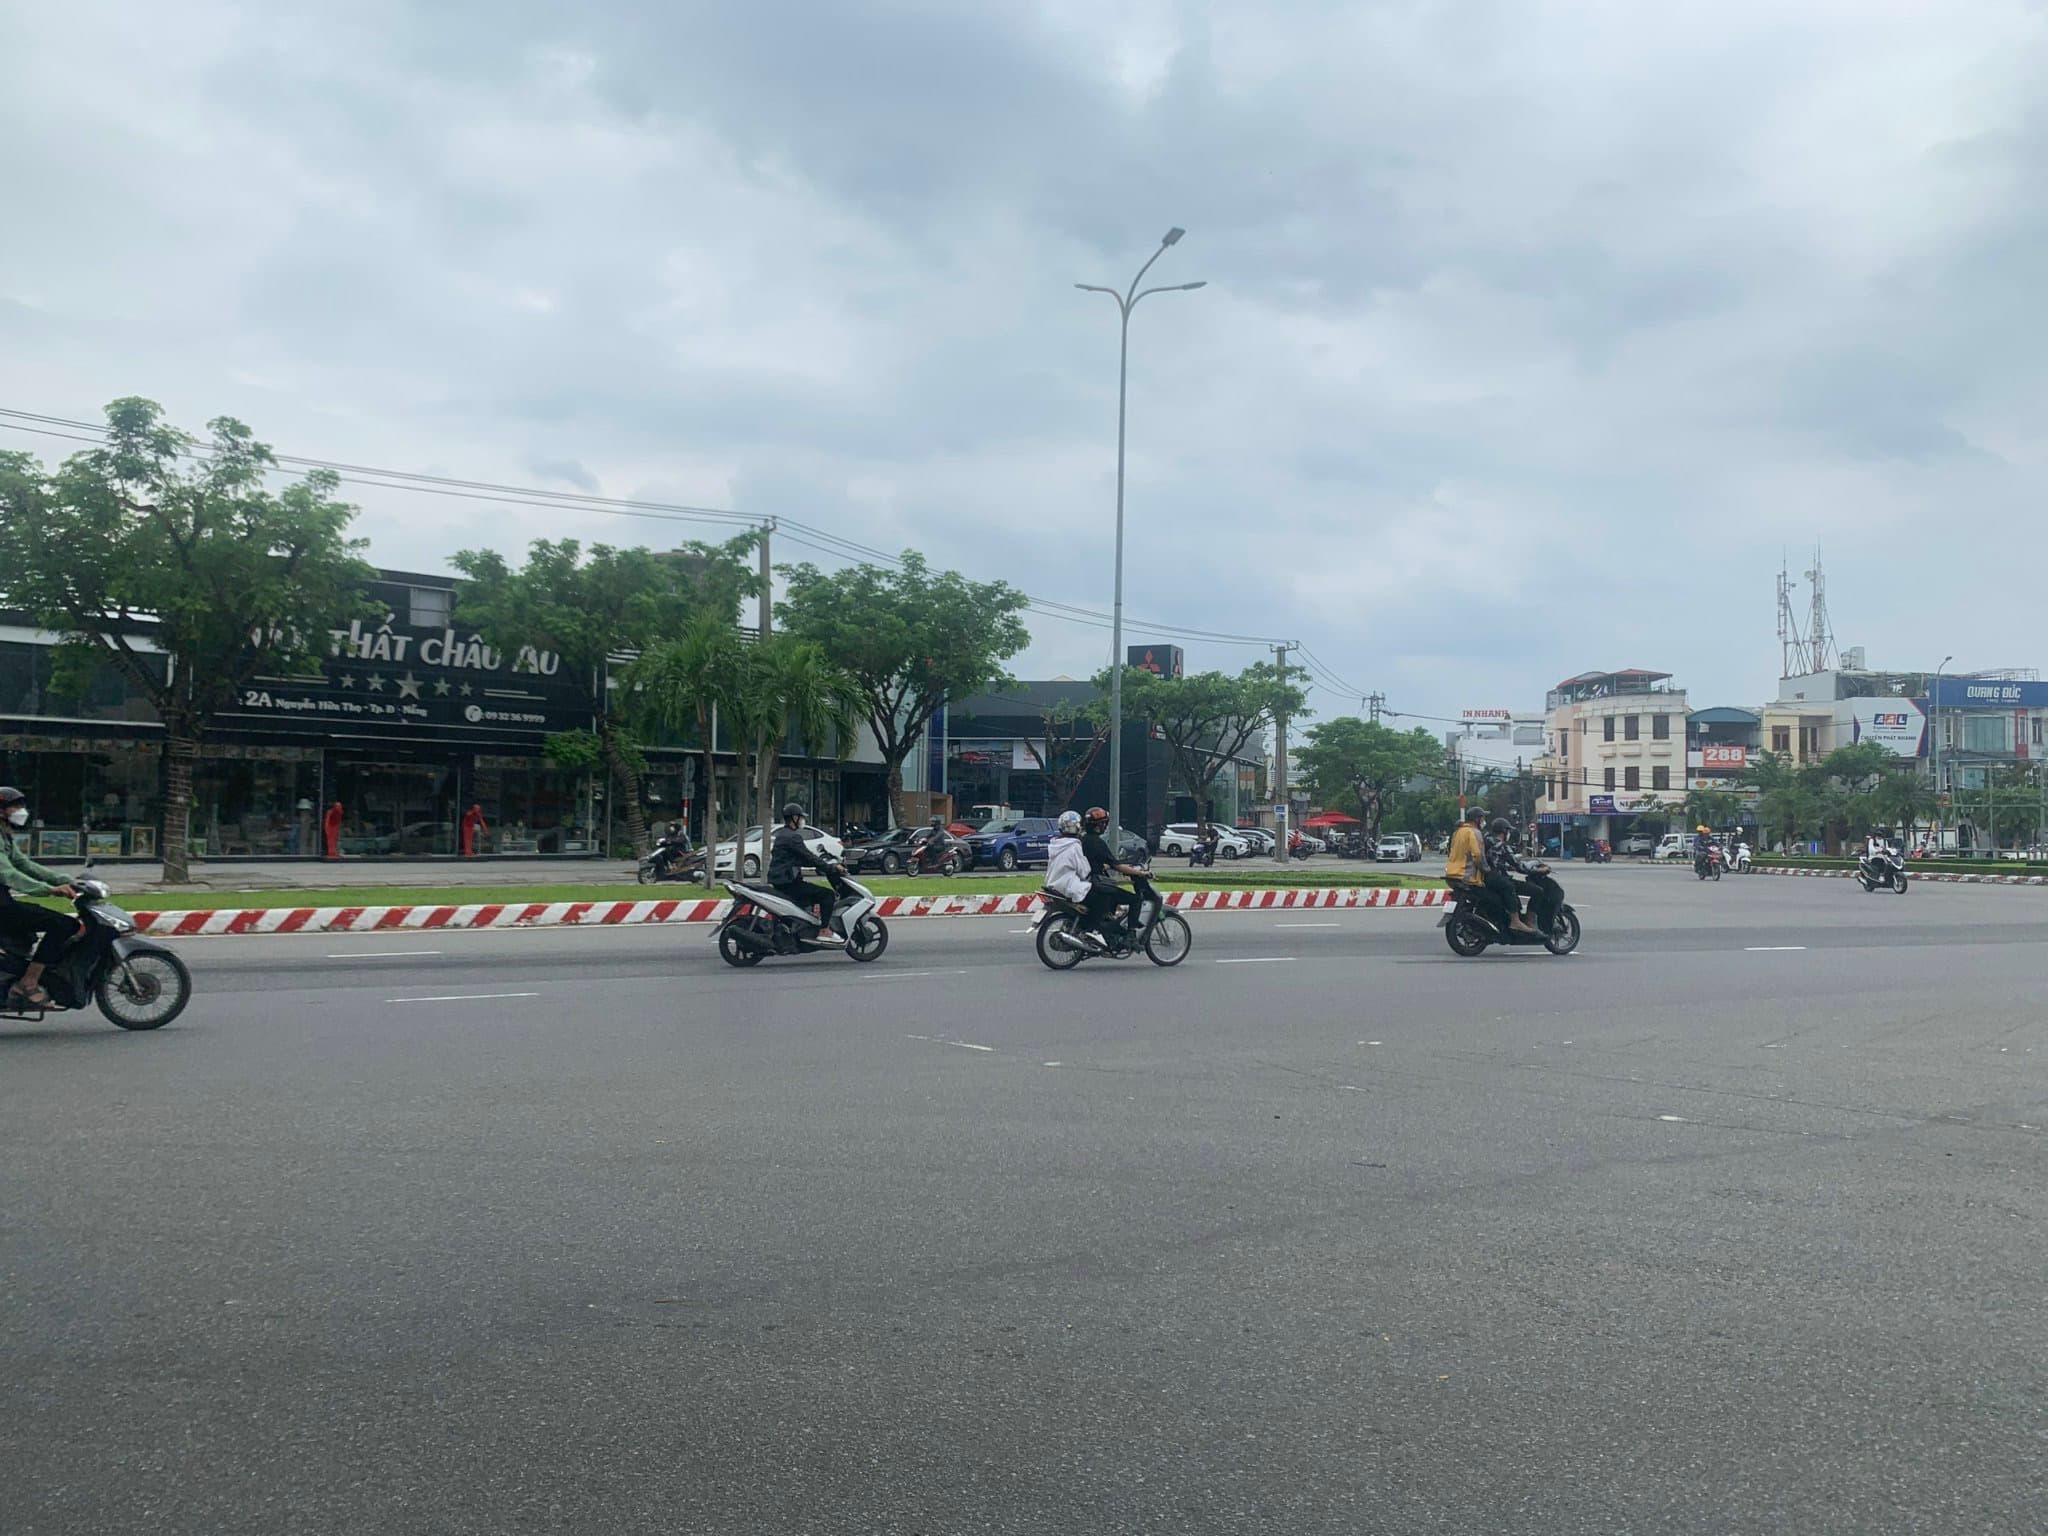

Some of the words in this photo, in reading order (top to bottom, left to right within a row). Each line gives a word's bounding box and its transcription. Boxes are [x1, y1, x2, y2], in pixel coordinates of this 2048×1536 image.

[1966, 686, 2000, 698] QUANG
[246, 691, 272, 708] 2A
[275, 697, 316, 711] Nguyễn
[1462, 709, 1473, 718] IN
[1705, 748, 1743, 761] 288
